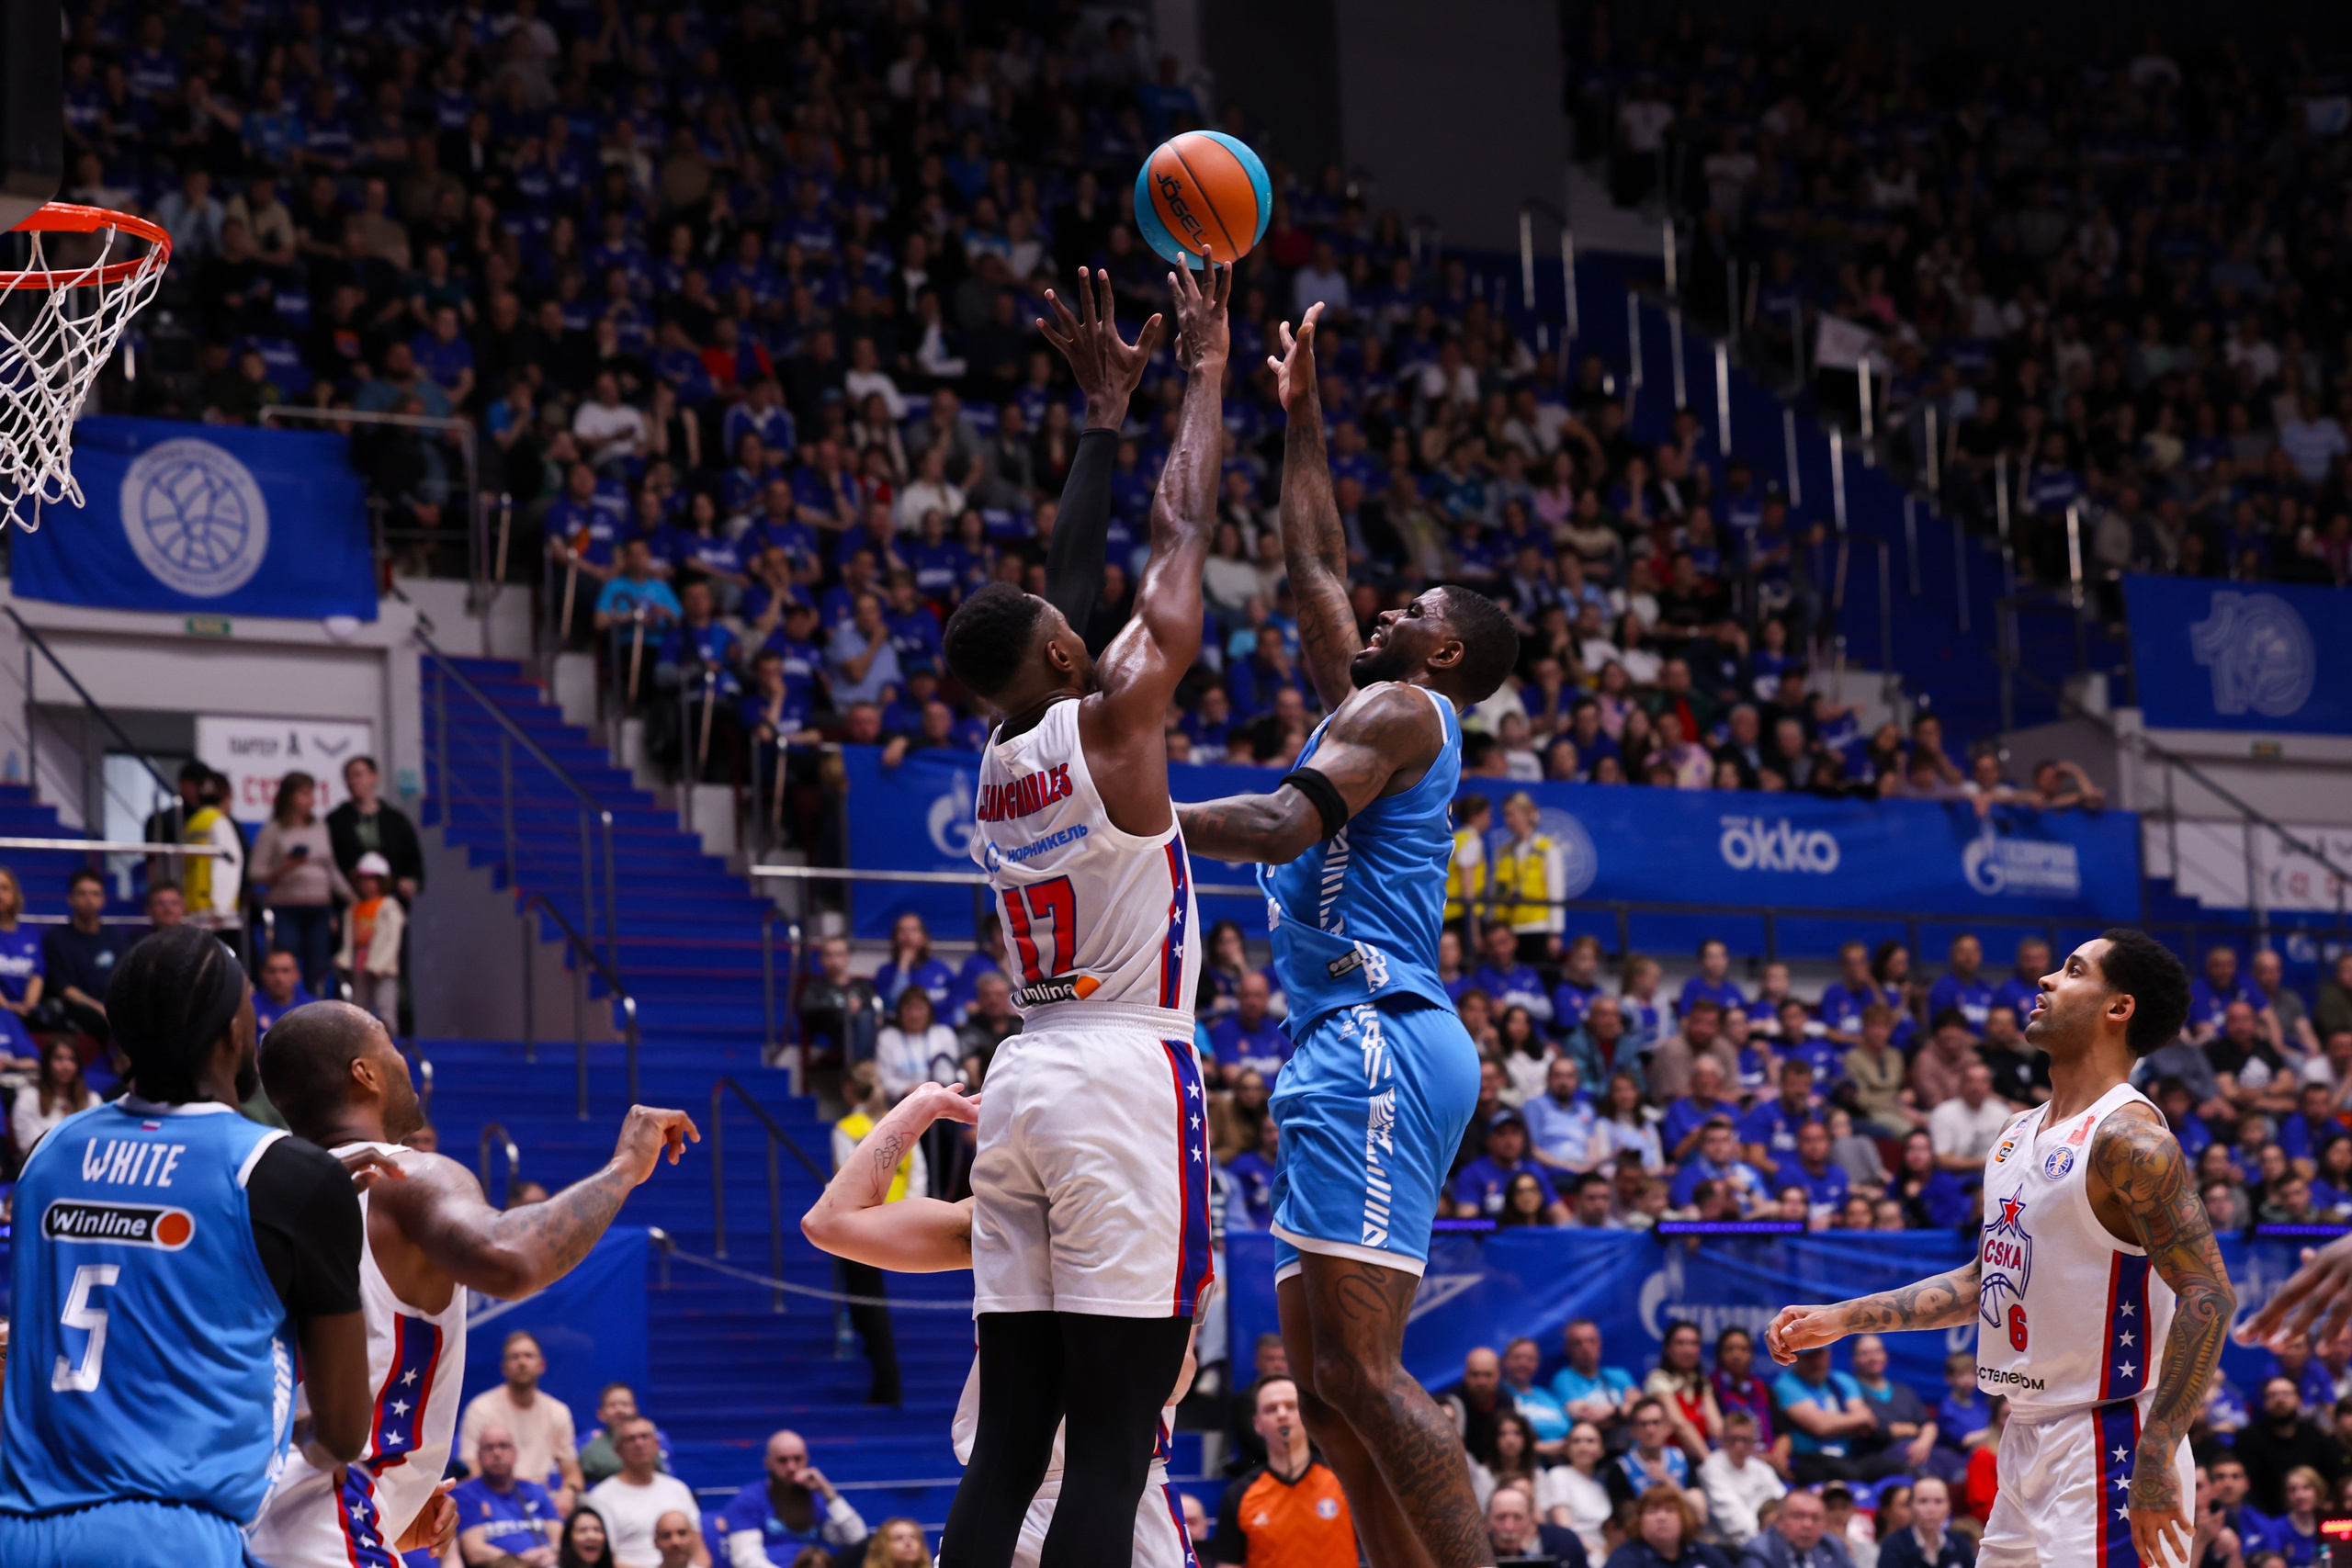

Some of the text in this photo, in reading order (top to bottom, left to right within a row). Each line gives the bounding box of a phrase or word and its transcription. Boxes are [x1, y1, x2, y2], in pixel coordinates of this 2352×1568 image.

[1155, 171, 1207, 248] JÖGEL
[1007, 823, 1089, 863] НОРНИКЕЛЬ
[1001, 874, 1077, 982] 17
[82, 1137, 187, 1188] WHITE
[52, 1208, 148, 1237] Winline
[1984, 1238, 2022, 1271] CSKA
[51, 1264, 120, 1392] 5
[2008, 1303, 2029, 1353] 6
[1976, 1365, 2045, 1391] стелеом
